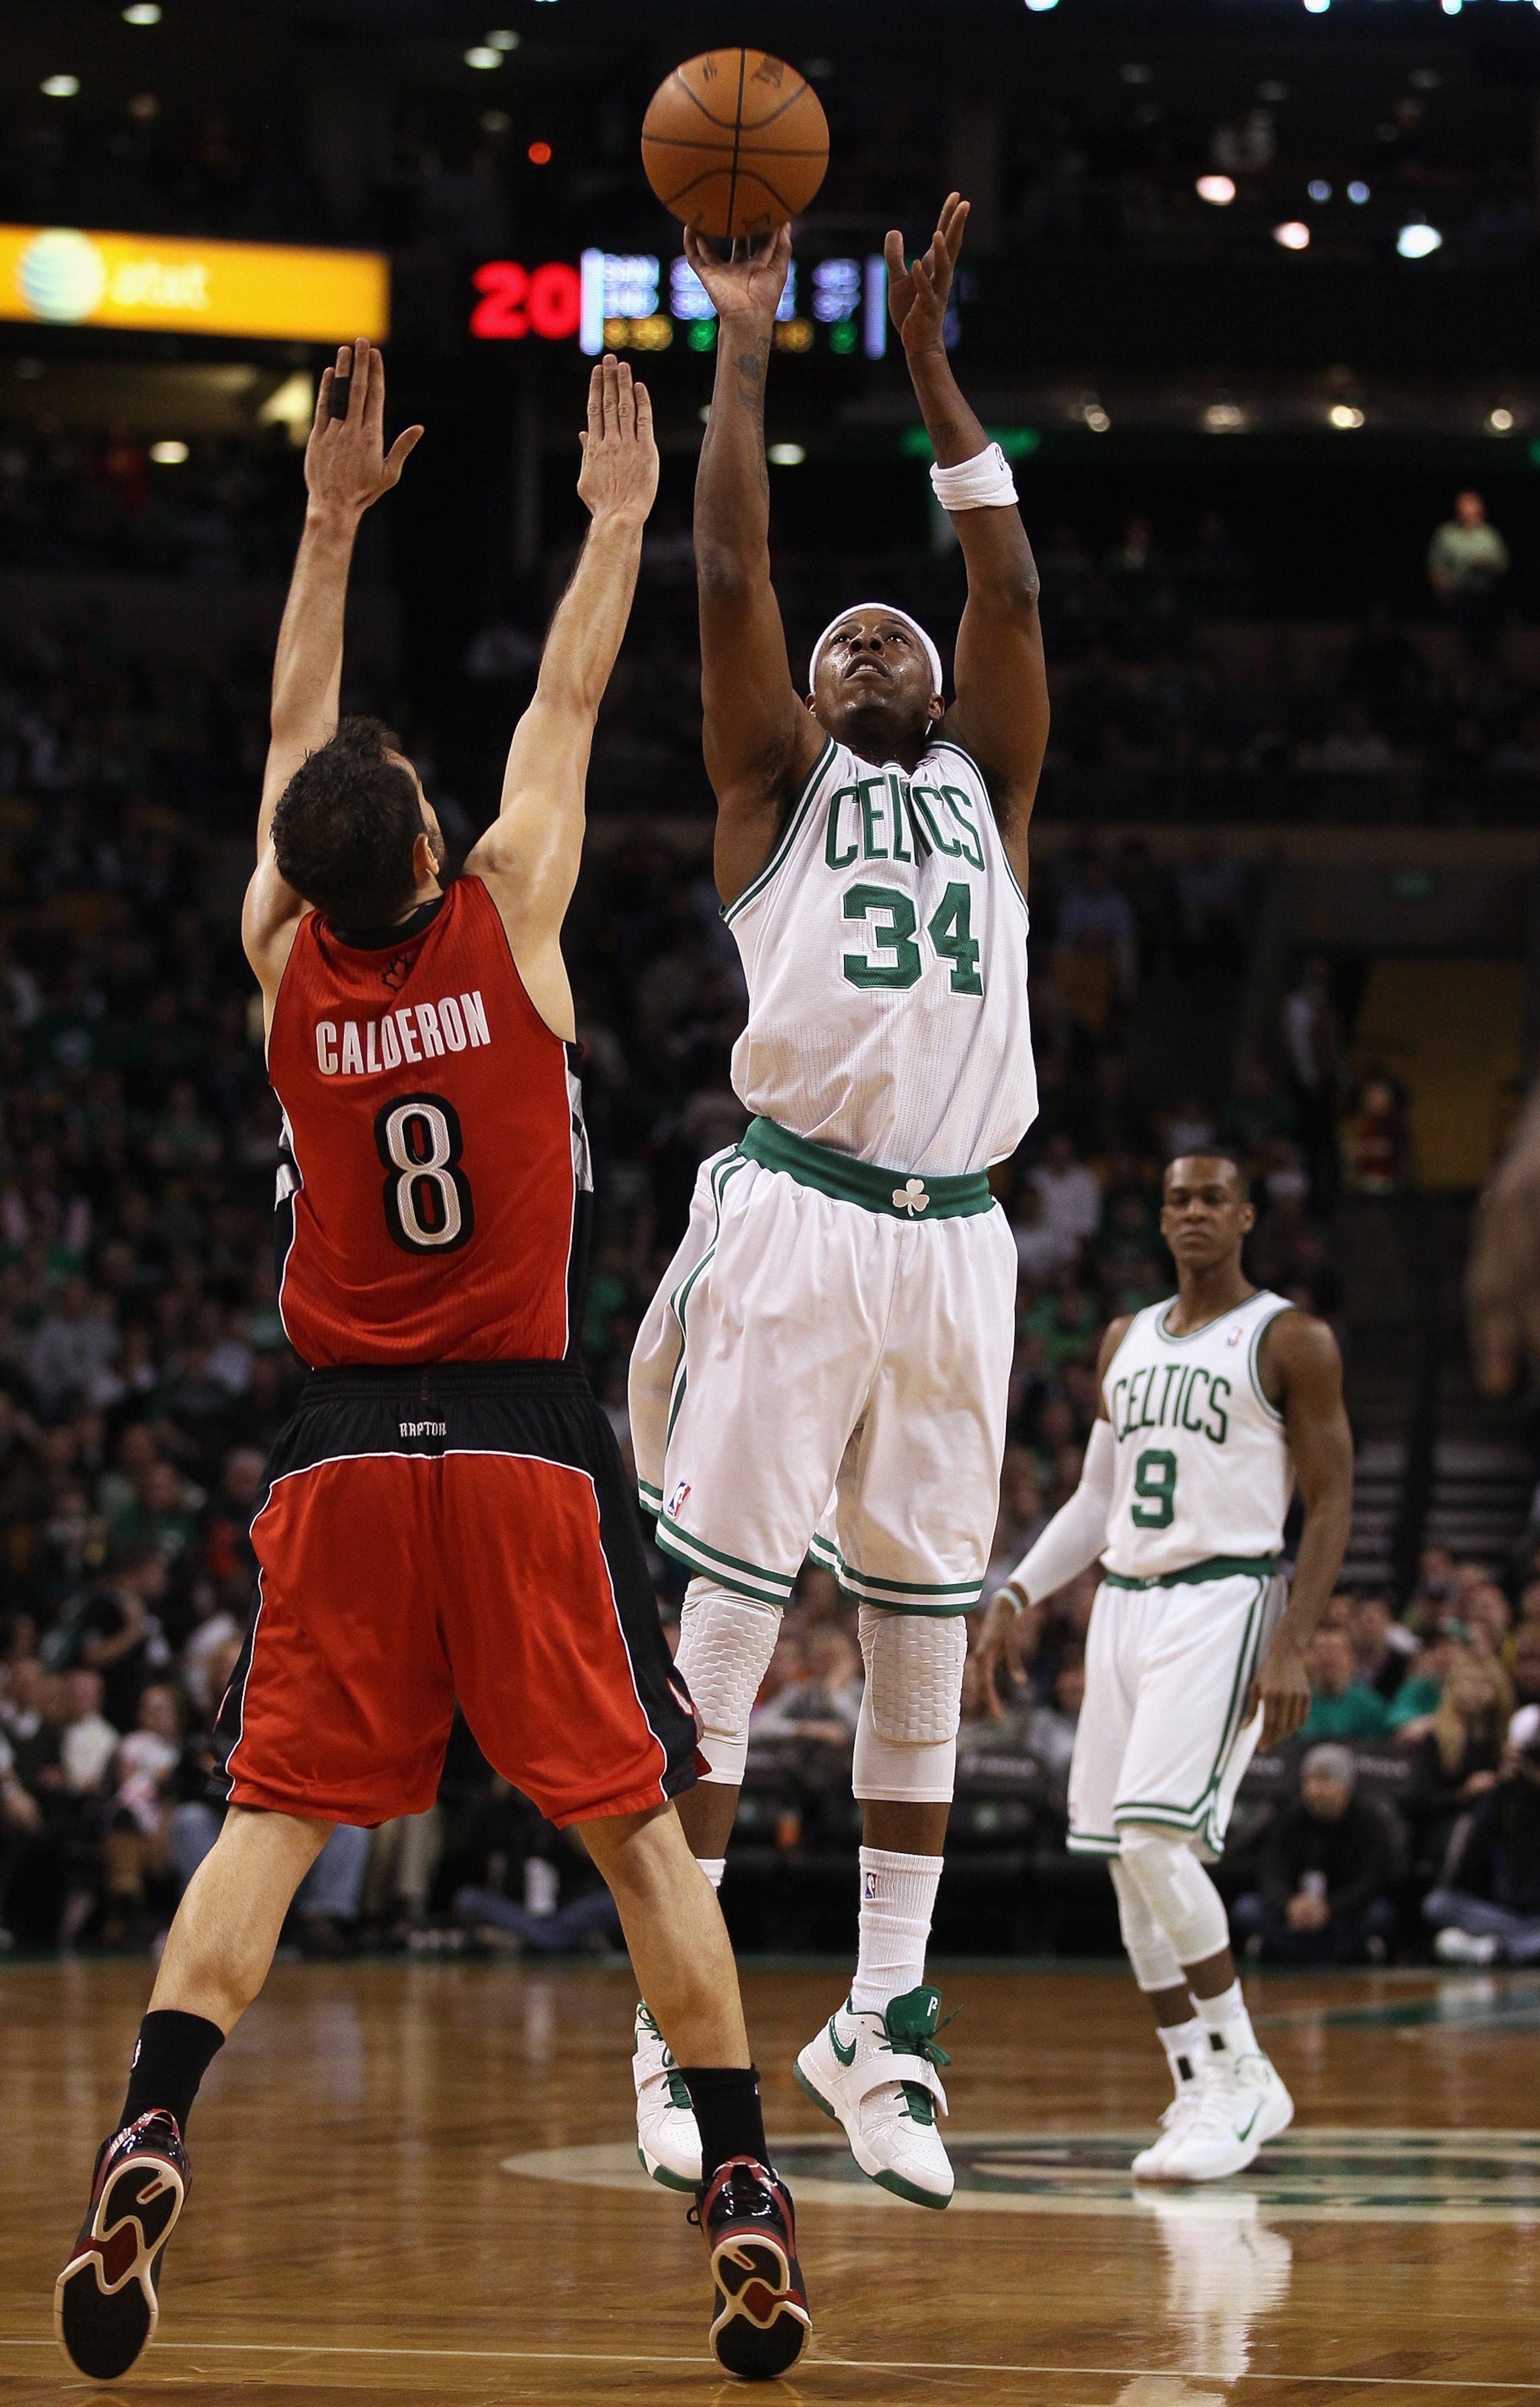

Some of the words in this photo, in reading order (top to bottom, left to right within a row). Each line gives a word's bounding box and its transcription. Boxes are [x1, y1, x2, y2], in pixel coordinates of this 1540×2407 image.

[471, 261, 579, 339] 20
[826, 774, 985, 871] CELICS
[843, 882, 983, 996] 34
[316, 990, 491, 1075] CALDERON
[374, 1092, 475, 1256] 8
[399, 1421, 447, 1437] RAPTOR
[1113, 1364, 1232, 1444] CELTICS
[1131, 1450, 1177, 1529] 9
